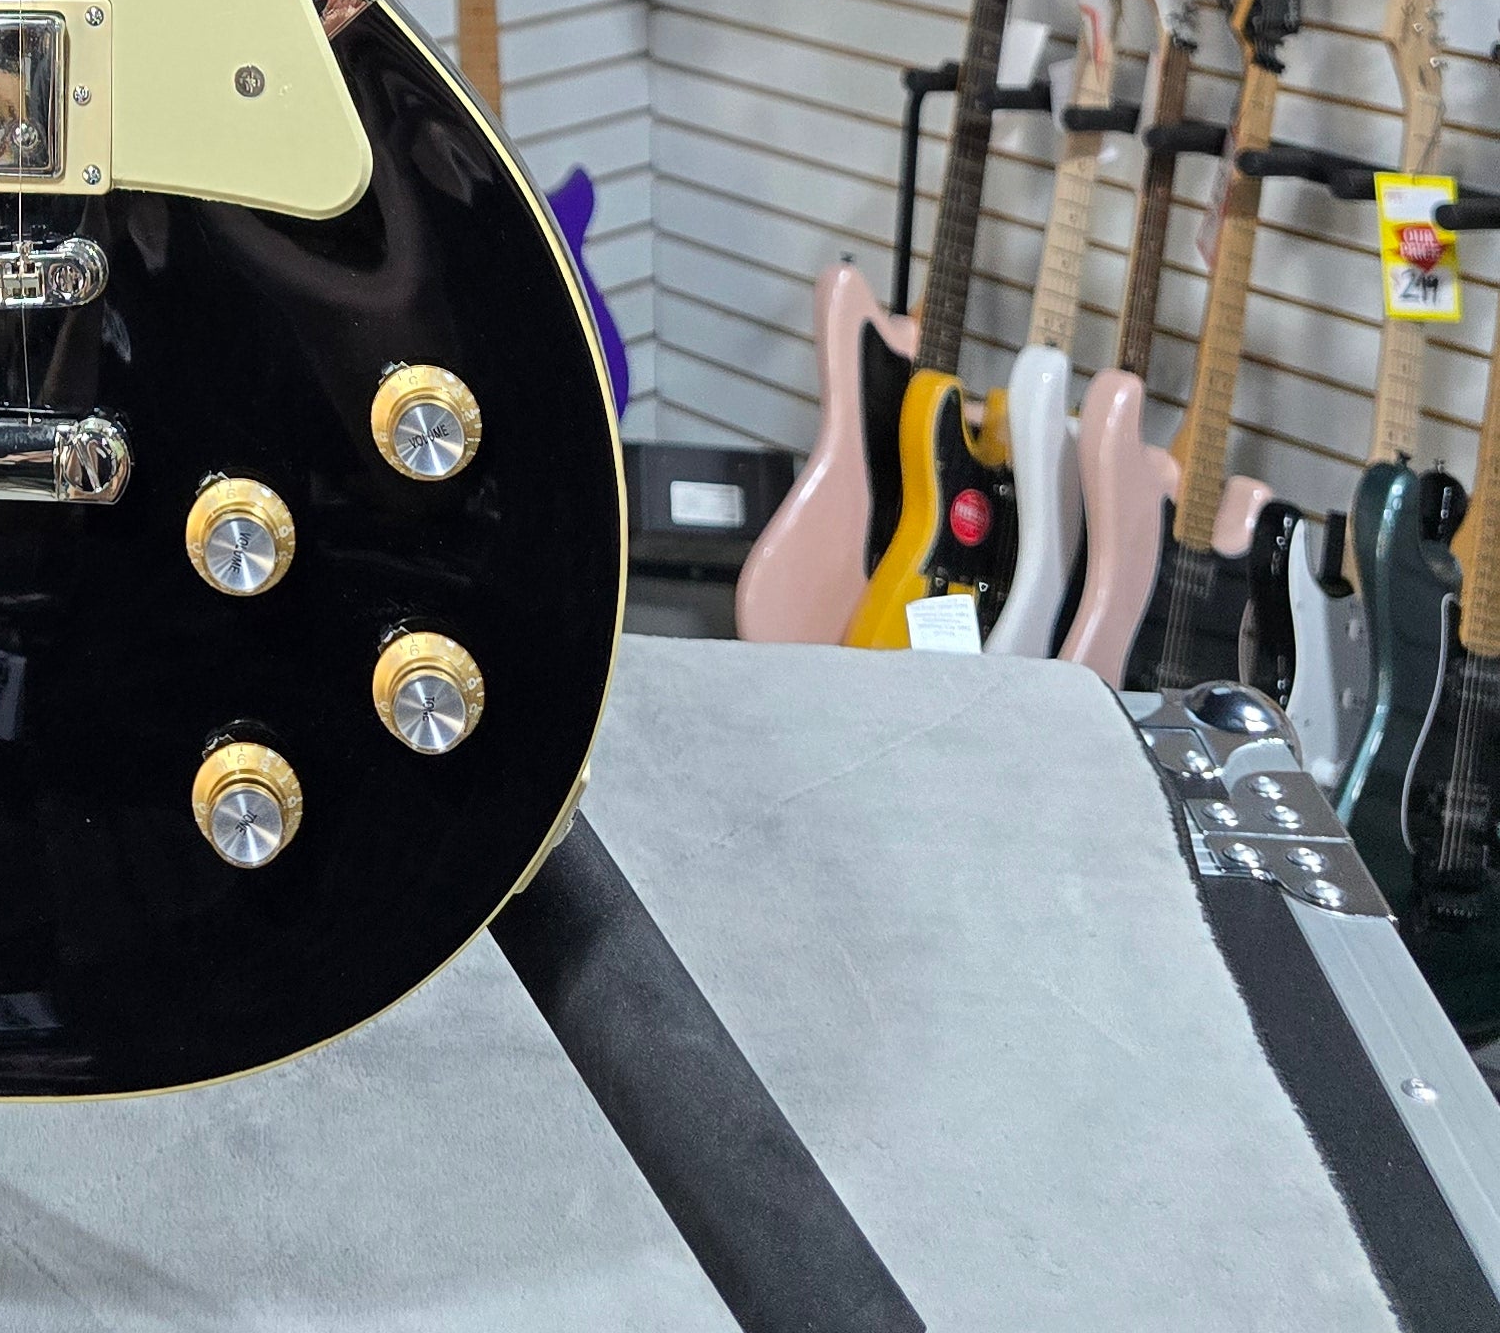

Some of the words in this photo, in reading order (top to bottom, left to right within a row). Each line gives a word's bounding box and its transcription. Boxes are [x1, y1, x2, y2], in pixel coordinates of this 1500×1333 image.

[408, 424, 450, 448] VOLUME
[227, 532, 252, 574] VOLUME
[422, 696, 436, 722] TONE
[234, 809, 258, 836] TONE
